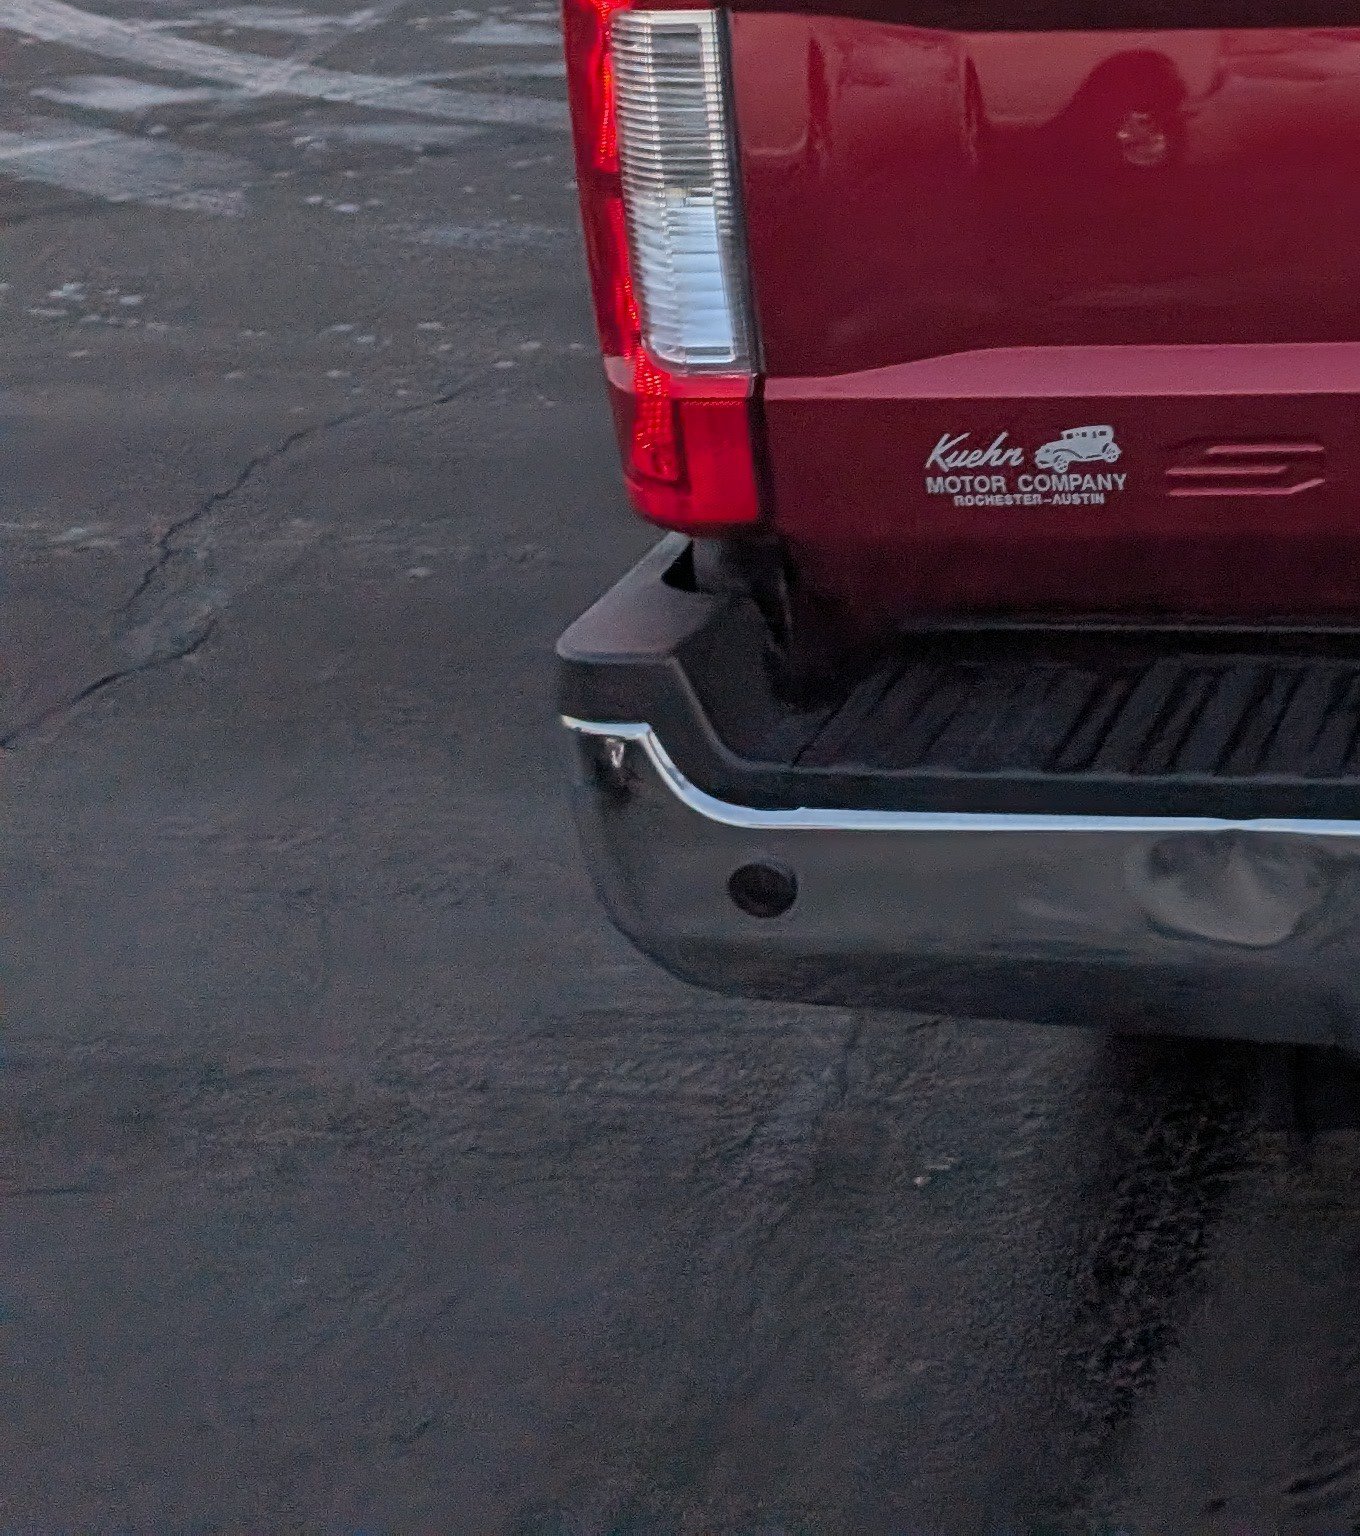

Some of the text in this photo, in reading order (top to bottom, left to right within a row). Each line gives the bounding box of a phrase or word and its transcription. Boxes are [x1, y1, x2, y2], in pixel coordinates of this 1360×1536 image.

[925, 430, 1024, 472] Kuehn
[926, 473, 1127, 494] MOTOR COMPANY
